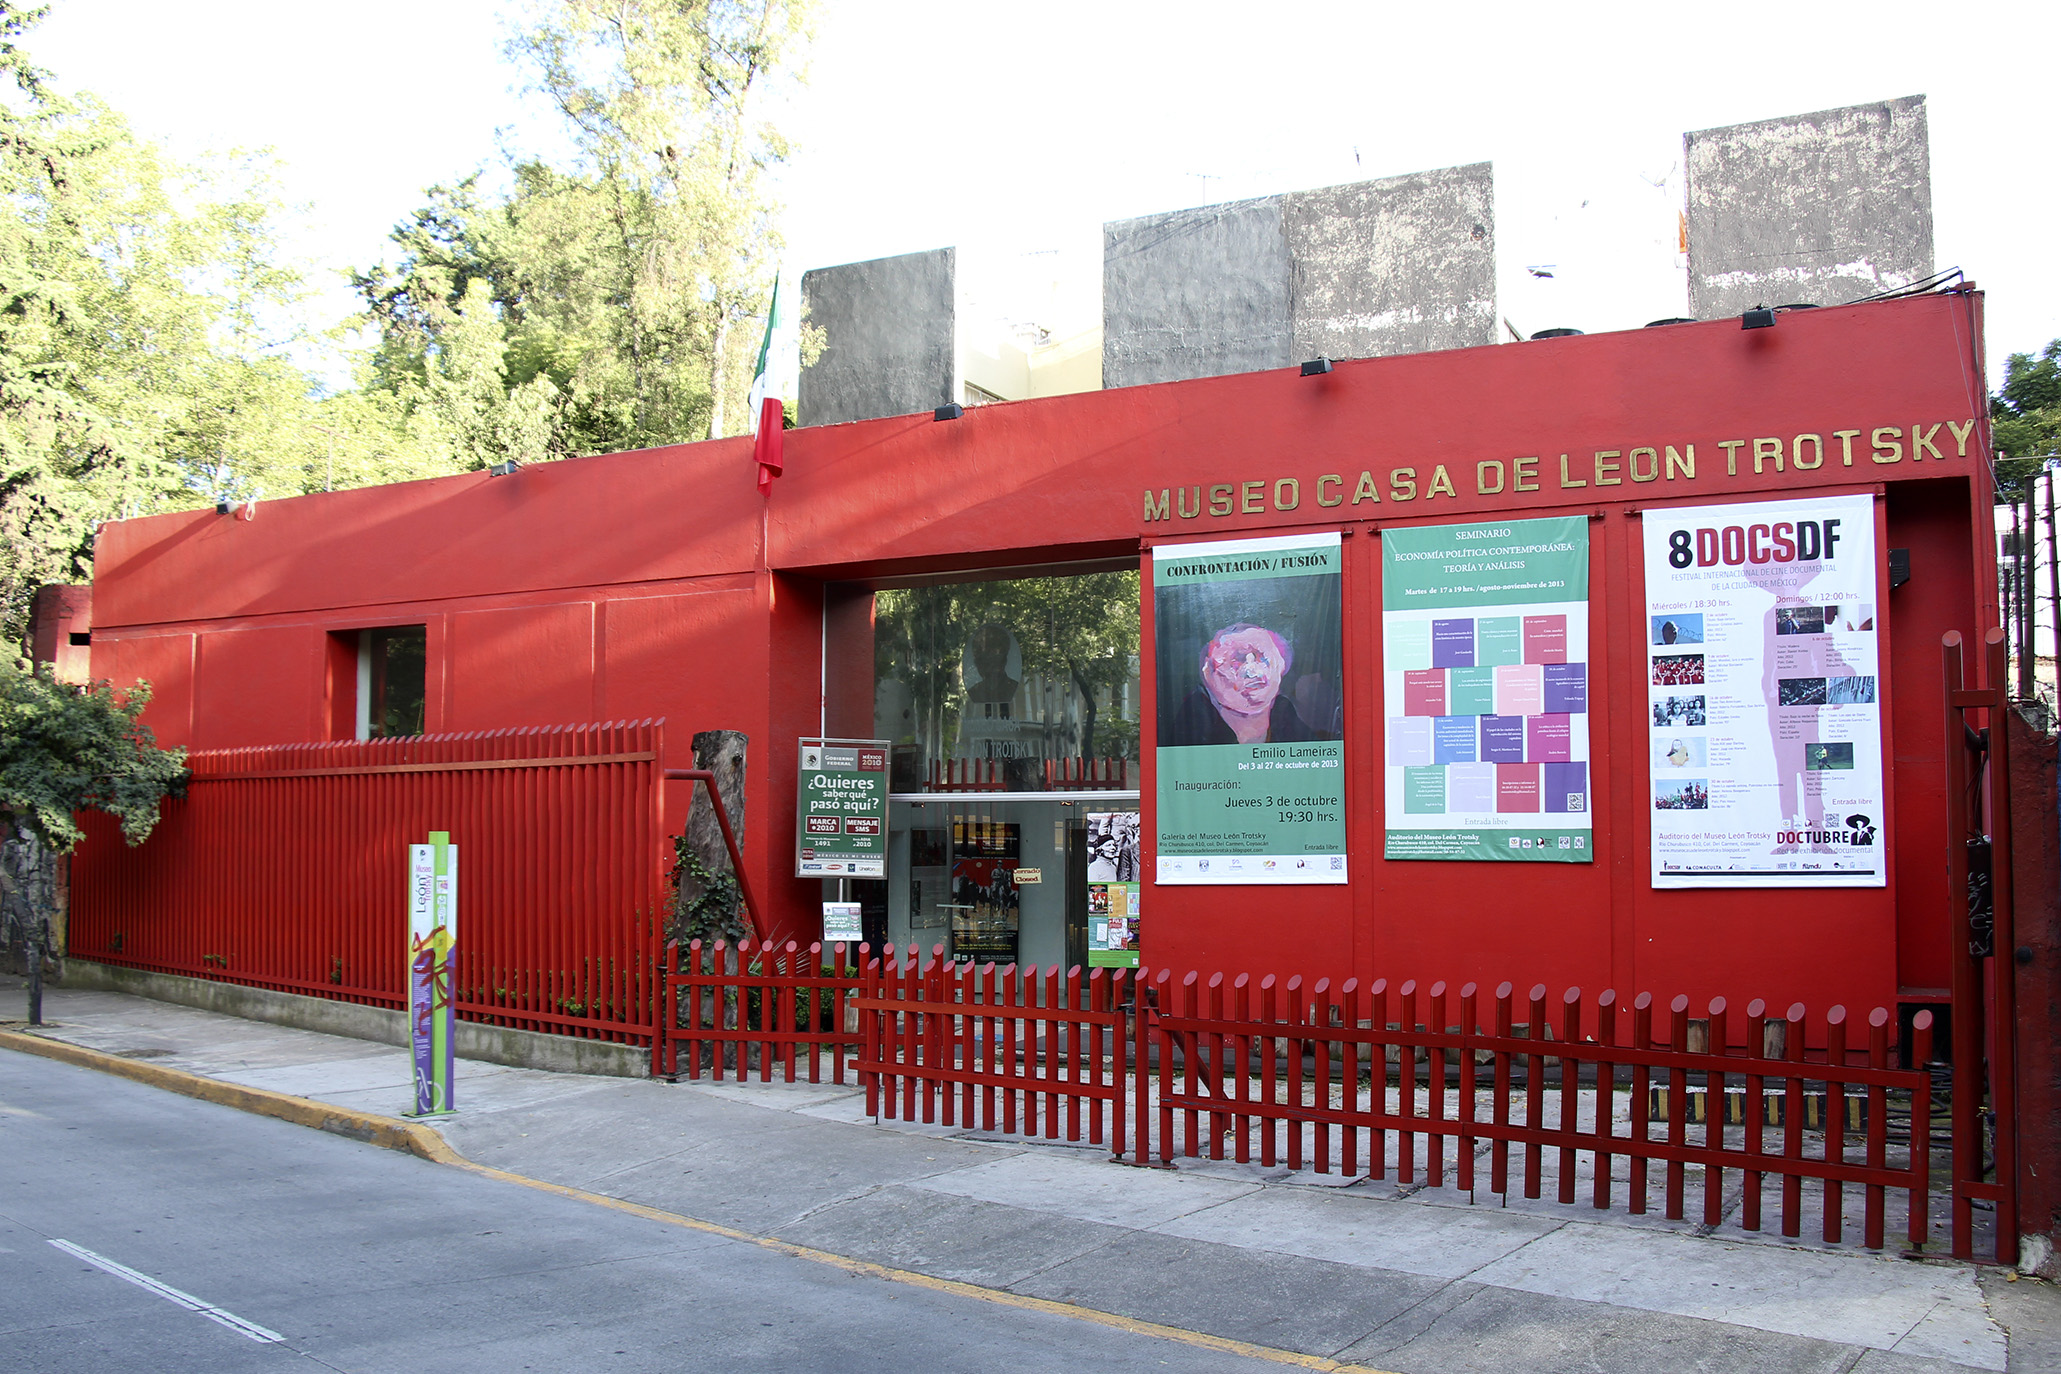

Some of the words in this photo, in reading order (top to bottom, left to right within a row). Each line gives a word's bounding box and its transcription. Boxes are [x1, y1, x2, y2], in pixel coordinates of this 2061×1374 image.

[1144, 477, 1299, 522] MUSEO
[1316, 464, 1456, 507] CASA
[1476, 456, 1540, 495] DE
[1560, 443, 1695, 488] LEON
[1718, 419, 1975, 476] TROTSKY
[1455, 528, 1511, 540] SEMINARIO
[1395, 549, 1444, 561] ECONOMÍA
[1446, 548, 1488, 559] POLÍTICA
[1489, 543, 1575, 557] CONTEMPORÁNEA:
[1167, 558, 1269, 577] CONFRONTACIÓN
[1272, 559, 1278, 571] /
[1281, 553, 1328, 569] FUSIÓN
[1443, 563, 1476, 574] TEORÍA
[1478, 563, 1484, 571] Y
[1484, 560, 1525, 571] ANÁLISIS
[1672, 572, 1702, 581] FESTIVAL
[1704, 568, 1759, 580] INTERNACIONAL
[1760, 568, 1770, 576] DE
[1771, 567, 1788, 576] CINE
[1790, 564, 1837, 574] DOCUMENTAL
[1732, 581, 1758, 590] CIUDAD
[1770, 578, 1798, 588] MÉXICO
[1652, 602, 1688, 610] Miércoles
[1694, 600, 1716, 608] 18:30
[1718, 598, 1732, 607] hrs.
[1776, 595, 1812, 604] Domingos
[1820, 592, 1844, 601] 12:00
[1252, 748, 1286, 758] Emilio
[1289, 746, 1338, 758] Lameiras
[1238, 762, 1250, 770] Del
[1321, 760, 1338, 768] 2013
[808, 774, 874, 790] ¿Quieres
[1175, 780, 1241, 792] Inauguración:
[822, 789, 848, 798] saber
[849, 790, 866, 800] qué
[810, 798, 840, 812] pasó
[844, 798, 879, 814] aquí?
[1225, 797, 1262, 808] Jueves
[1266, 796, 1273, 807] 3
[1277, 796, 1290, 806] de
[1294, 795, 1338, 806] octubre
[1278, 811, 1313, 822] 19:30
[1317, 811, 1338, 822] hrs.
[1746, 832, 1771, 840] Trotsky
[1777, 831, 1849, 844] DOCTUBRE
[416, 876, 426, 913] León
